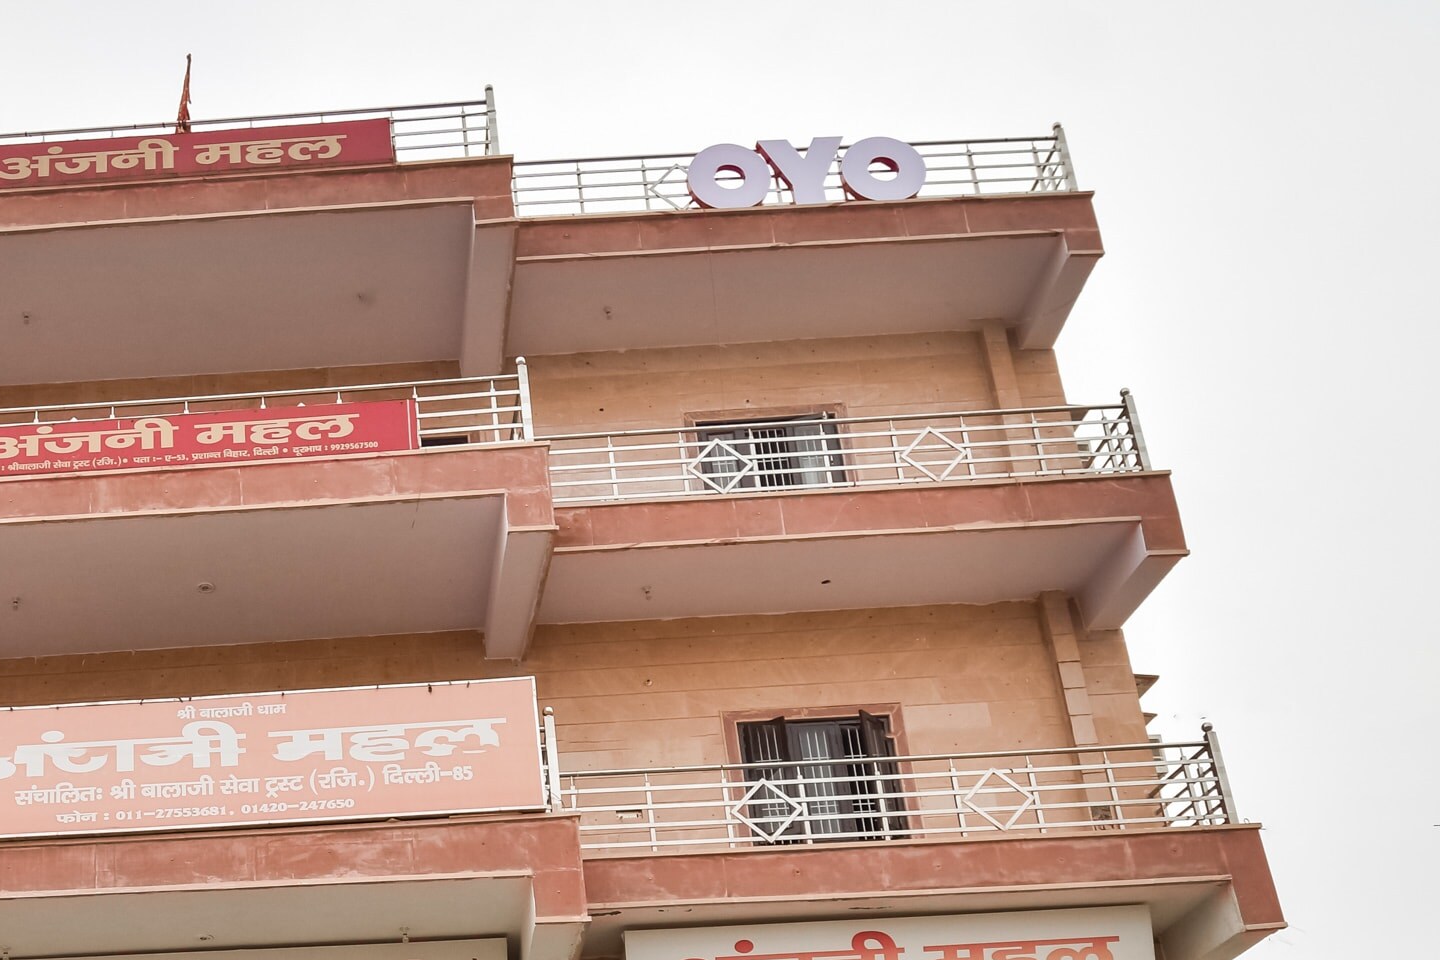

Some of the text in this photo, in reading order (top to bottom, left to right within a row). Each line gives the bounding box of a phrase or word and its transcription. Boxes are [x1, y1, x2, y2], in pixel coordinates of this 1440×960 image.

[192, 134, 347, 166] महल
[687, 136, 927, 209] OYO
[194, 414, 360, 445] महल
[330, 441, 379, 451] 9929567500
[177, 702, 287, 719] श्री बालाजी धाम
[269, 717, 507, 763] महल
[15, 761, 474, 805] संचालितः श्री बालाजी सेवा ट्रस्ट (रजि.) दिल्ली-85
[55, 810, 97, 824] फोन
[241, 798, 355, 815] 01420-247650
